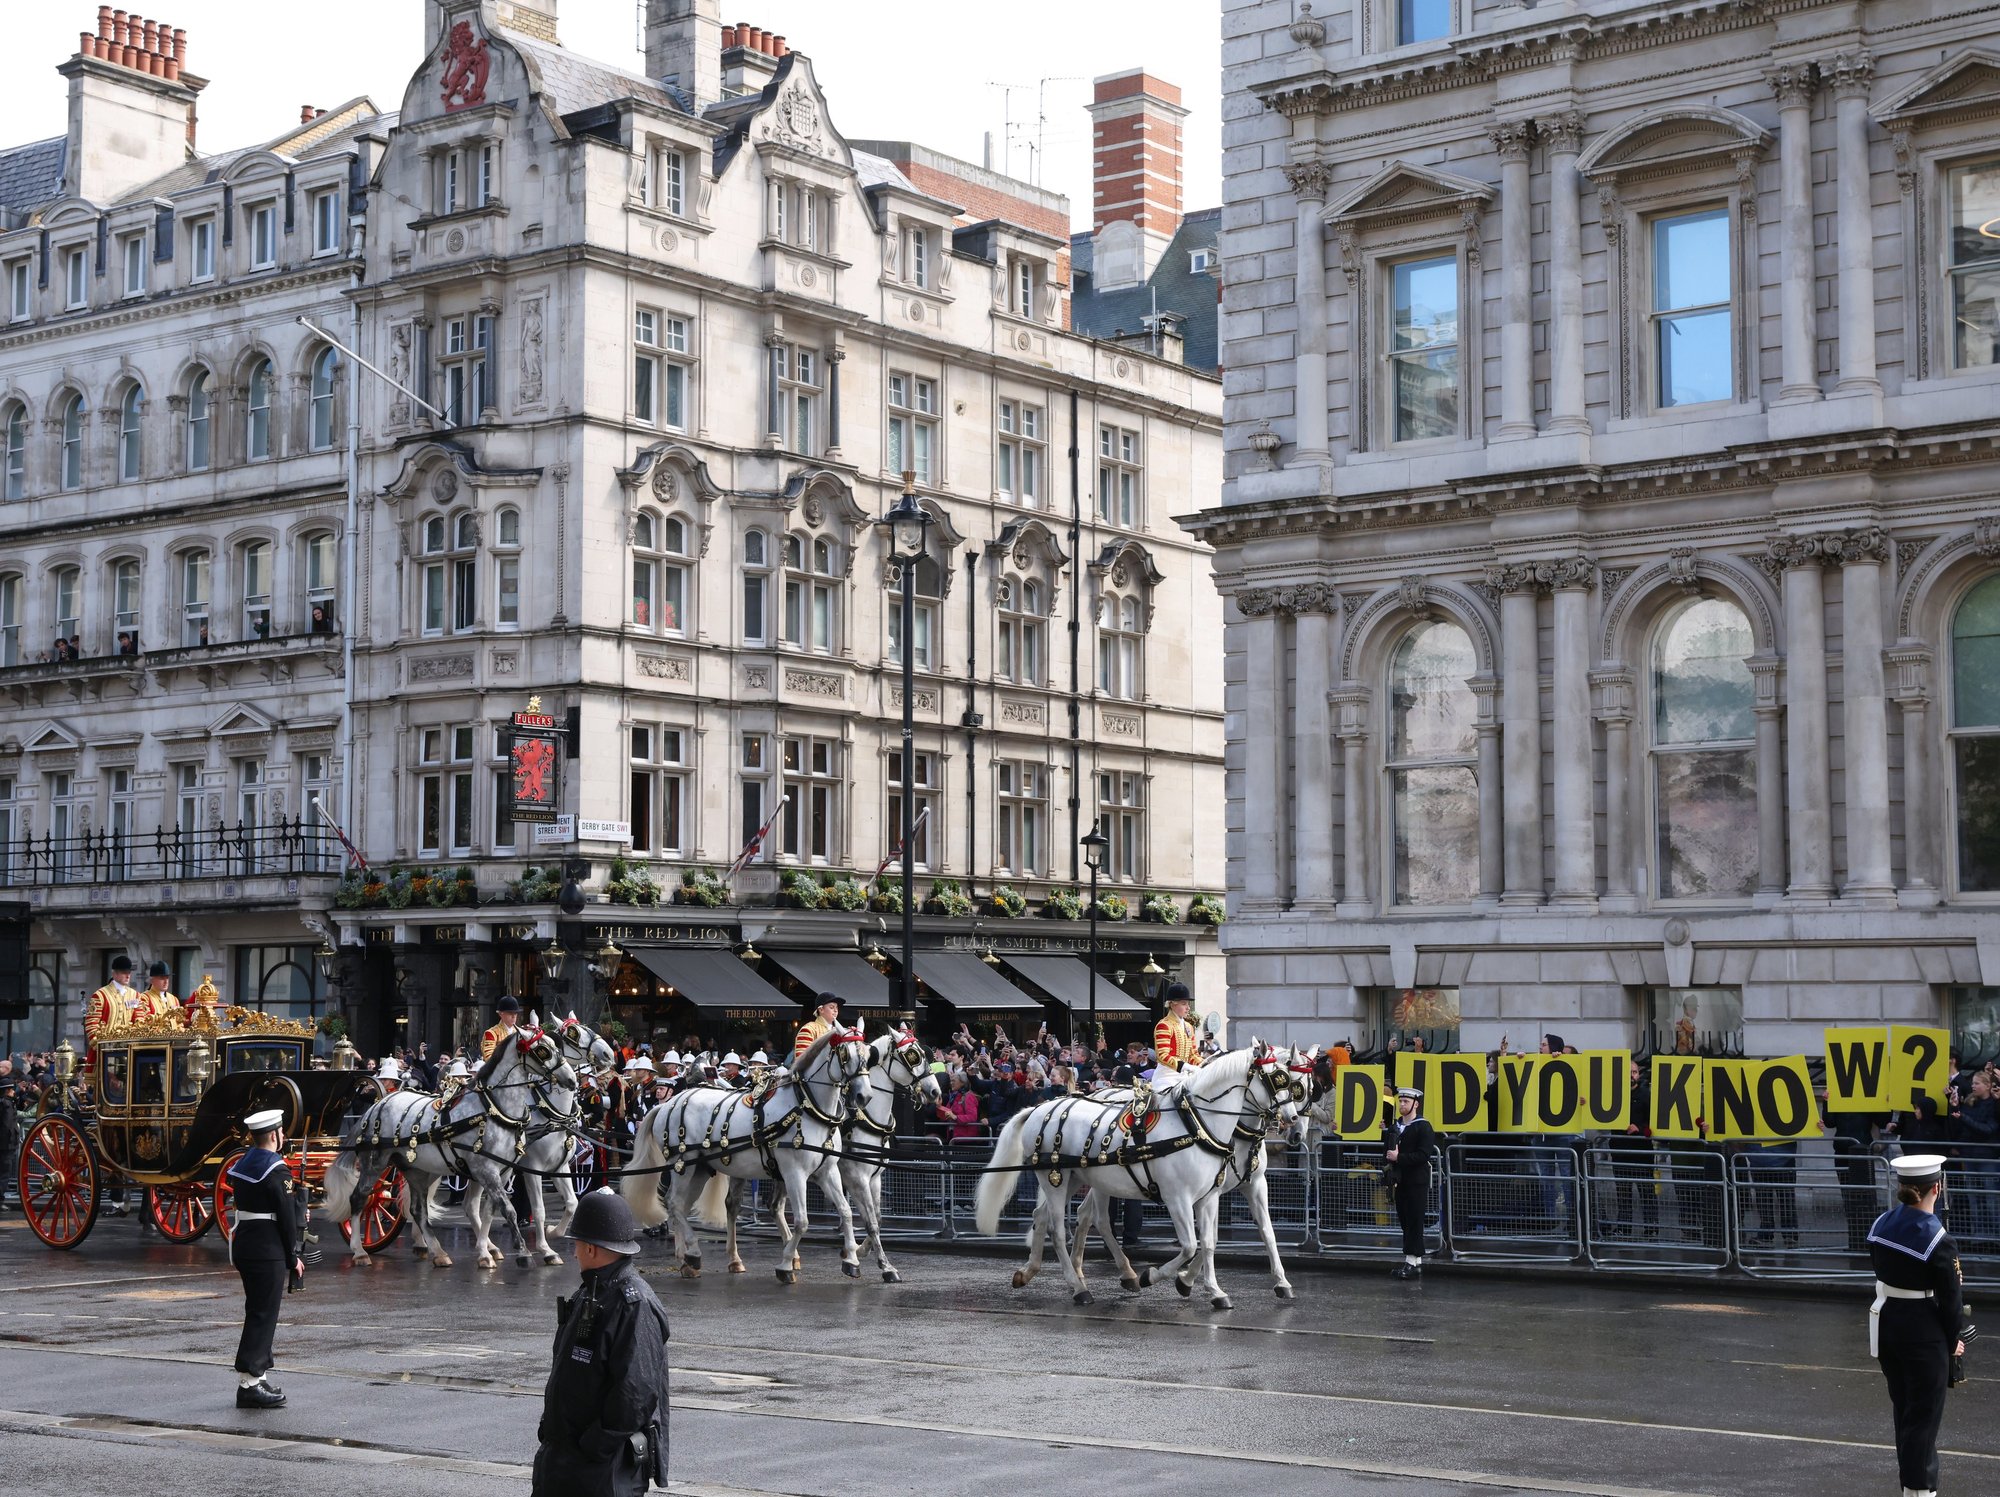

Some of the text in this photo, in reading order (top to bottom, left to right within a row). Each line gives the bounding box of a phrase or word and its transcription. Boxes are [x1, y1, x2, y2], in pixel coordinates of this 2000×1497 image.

[537, 826, 570, 834] STREET SW1
[581, 822, 628, 832] DERBY GATE SW1
[368, 929, 393, 941] TH
[498, 927, 529, 939] LIO
[595, 926, 730, 940] THE RED LION
[944, 935, 998, 948] FULLER
[1005, 937, 1049, 949] SMITH
[1055, 940, 1063, 949] &
[725, 1009, 776, 1018] THE RED LION
[857, 1009, 871, 1017] THE
[872, 1009, 886, 1017] RED
[977, 1012, 1020, 1021] THE RED LION
[1095, 1012, 1133, 1020] THE RED LION
[1340, 1059, 1482, 1134] DID
[1502, 1056, 1623, 1127] YOU
